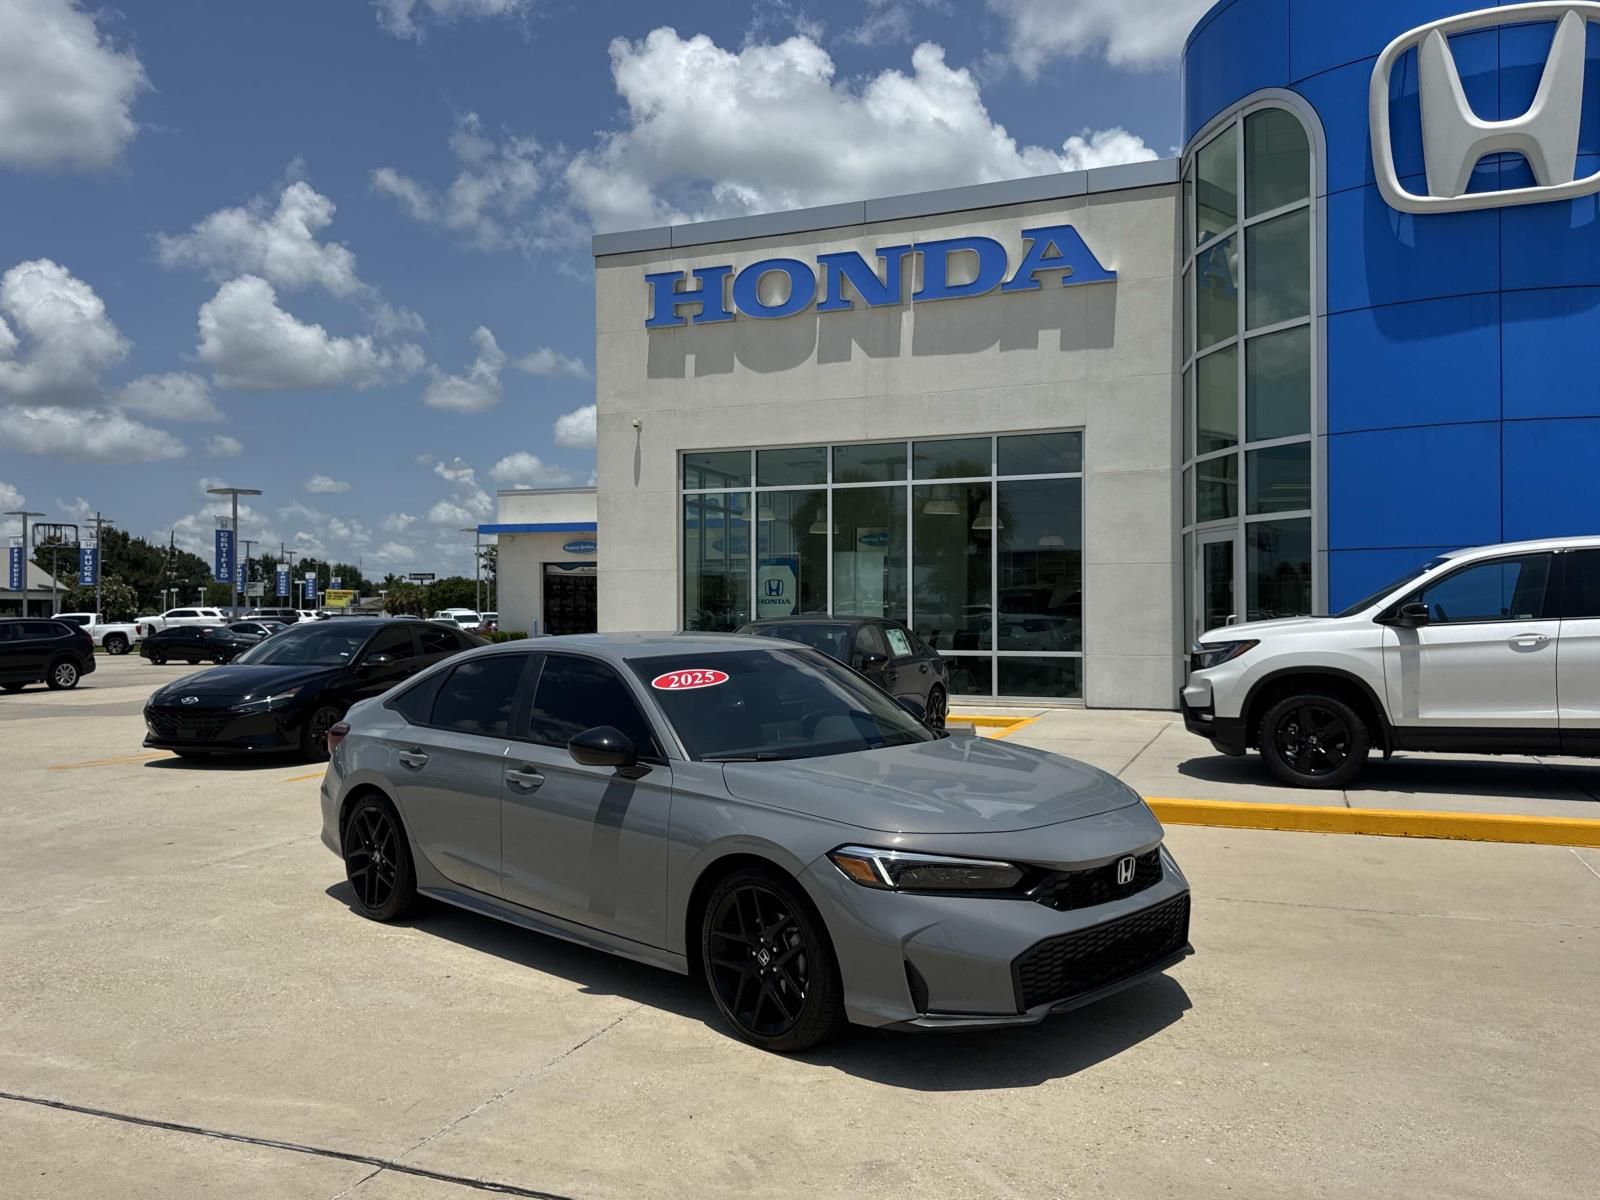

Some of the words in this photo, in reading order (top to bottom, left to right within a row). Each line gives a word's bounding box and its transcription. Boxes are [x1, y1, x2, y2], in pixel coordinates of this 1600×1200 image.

[645, 223, 1117, 329] HONDA
[84, 549, 93, 582] TRUCKS
[220, 532, 229, 578] CERTIFIED
[668, 671, 715, 688] 2025
